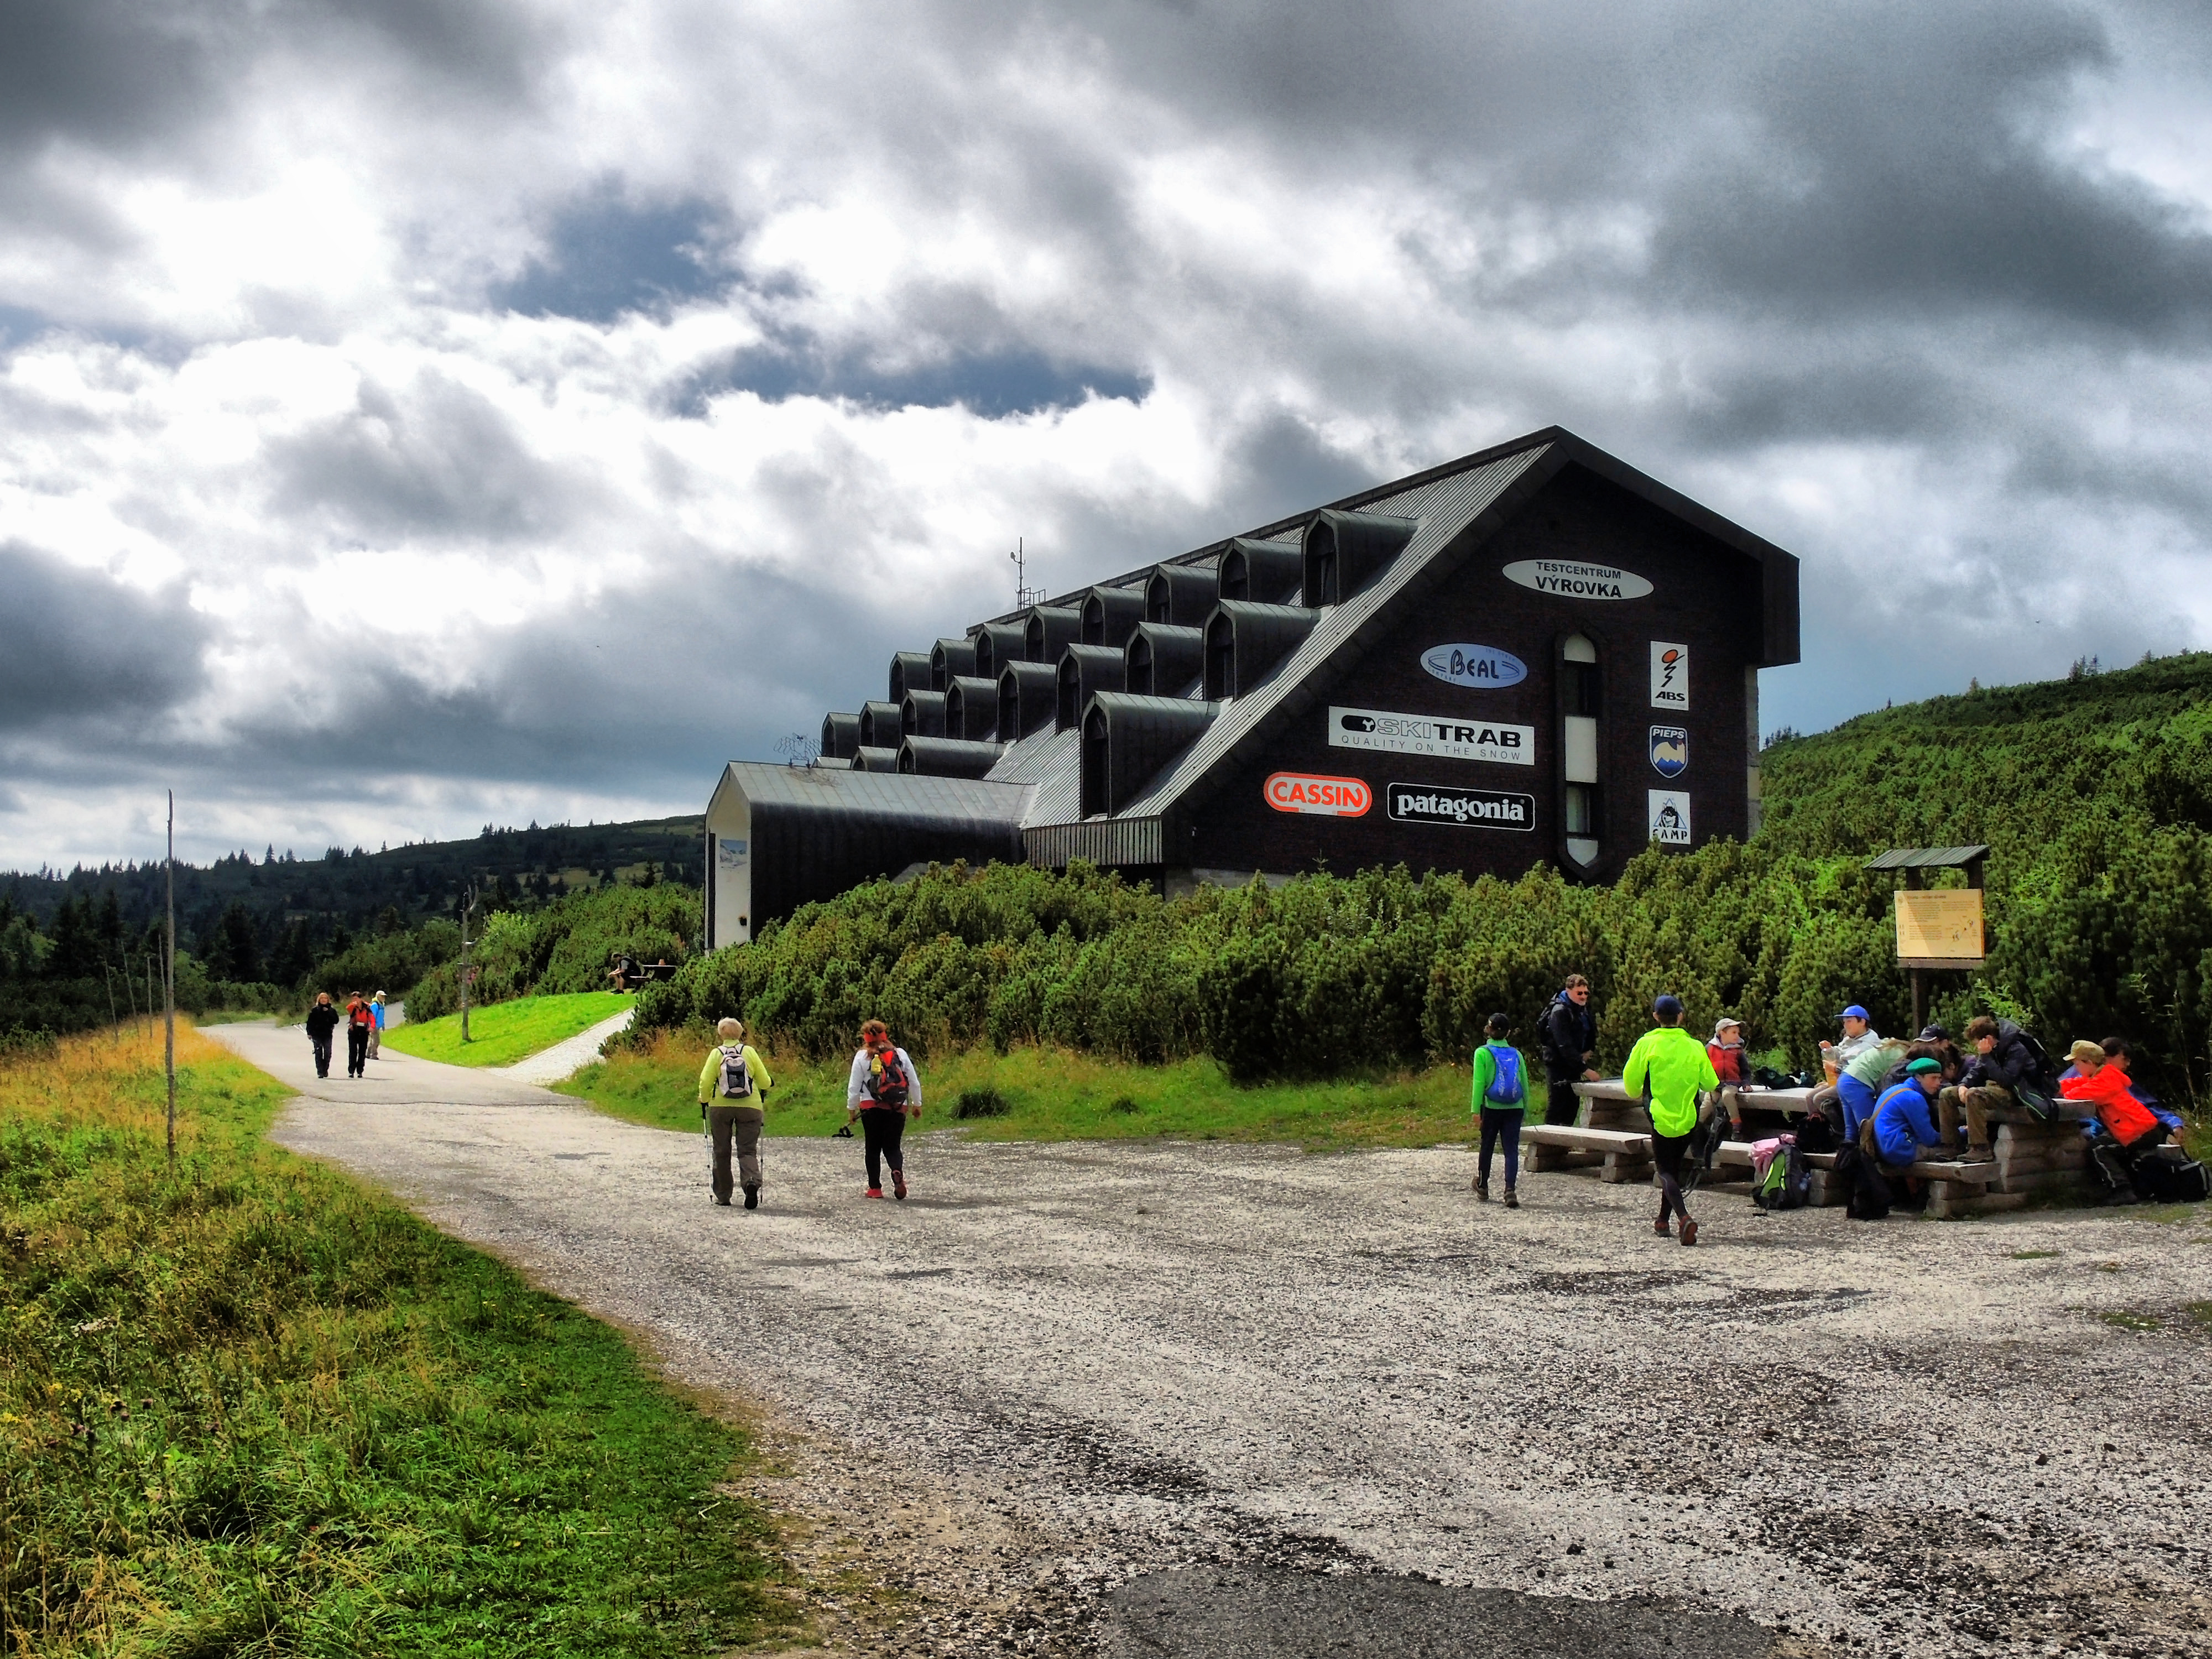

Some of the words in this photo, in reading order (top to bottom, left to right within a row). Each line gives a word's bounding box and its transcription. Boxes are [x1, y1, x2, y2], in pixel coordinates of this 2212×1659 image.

[1536, 561, 1621, 580] TESTCENTRUM
[1535, 575, 1622, 598] VÝROVKA
[1451, 649, 1499, 679] BEAL
[1655, 691, 1686, 701] ABS
[1377, 718, 1521, 748] SKITRAB
[1652, 728, 1685, 739] PIEPS
[1341, 735, 1405, 749] QUALITY
[1416, 742, 1433, 752] ON
[1444, 745, 1470, 756] THE
[1480, 748, 1520, 761] SNOW
[1273, 781, 1363, 807] CASSIN
[1397, 794, 1524, 821] patagonia
